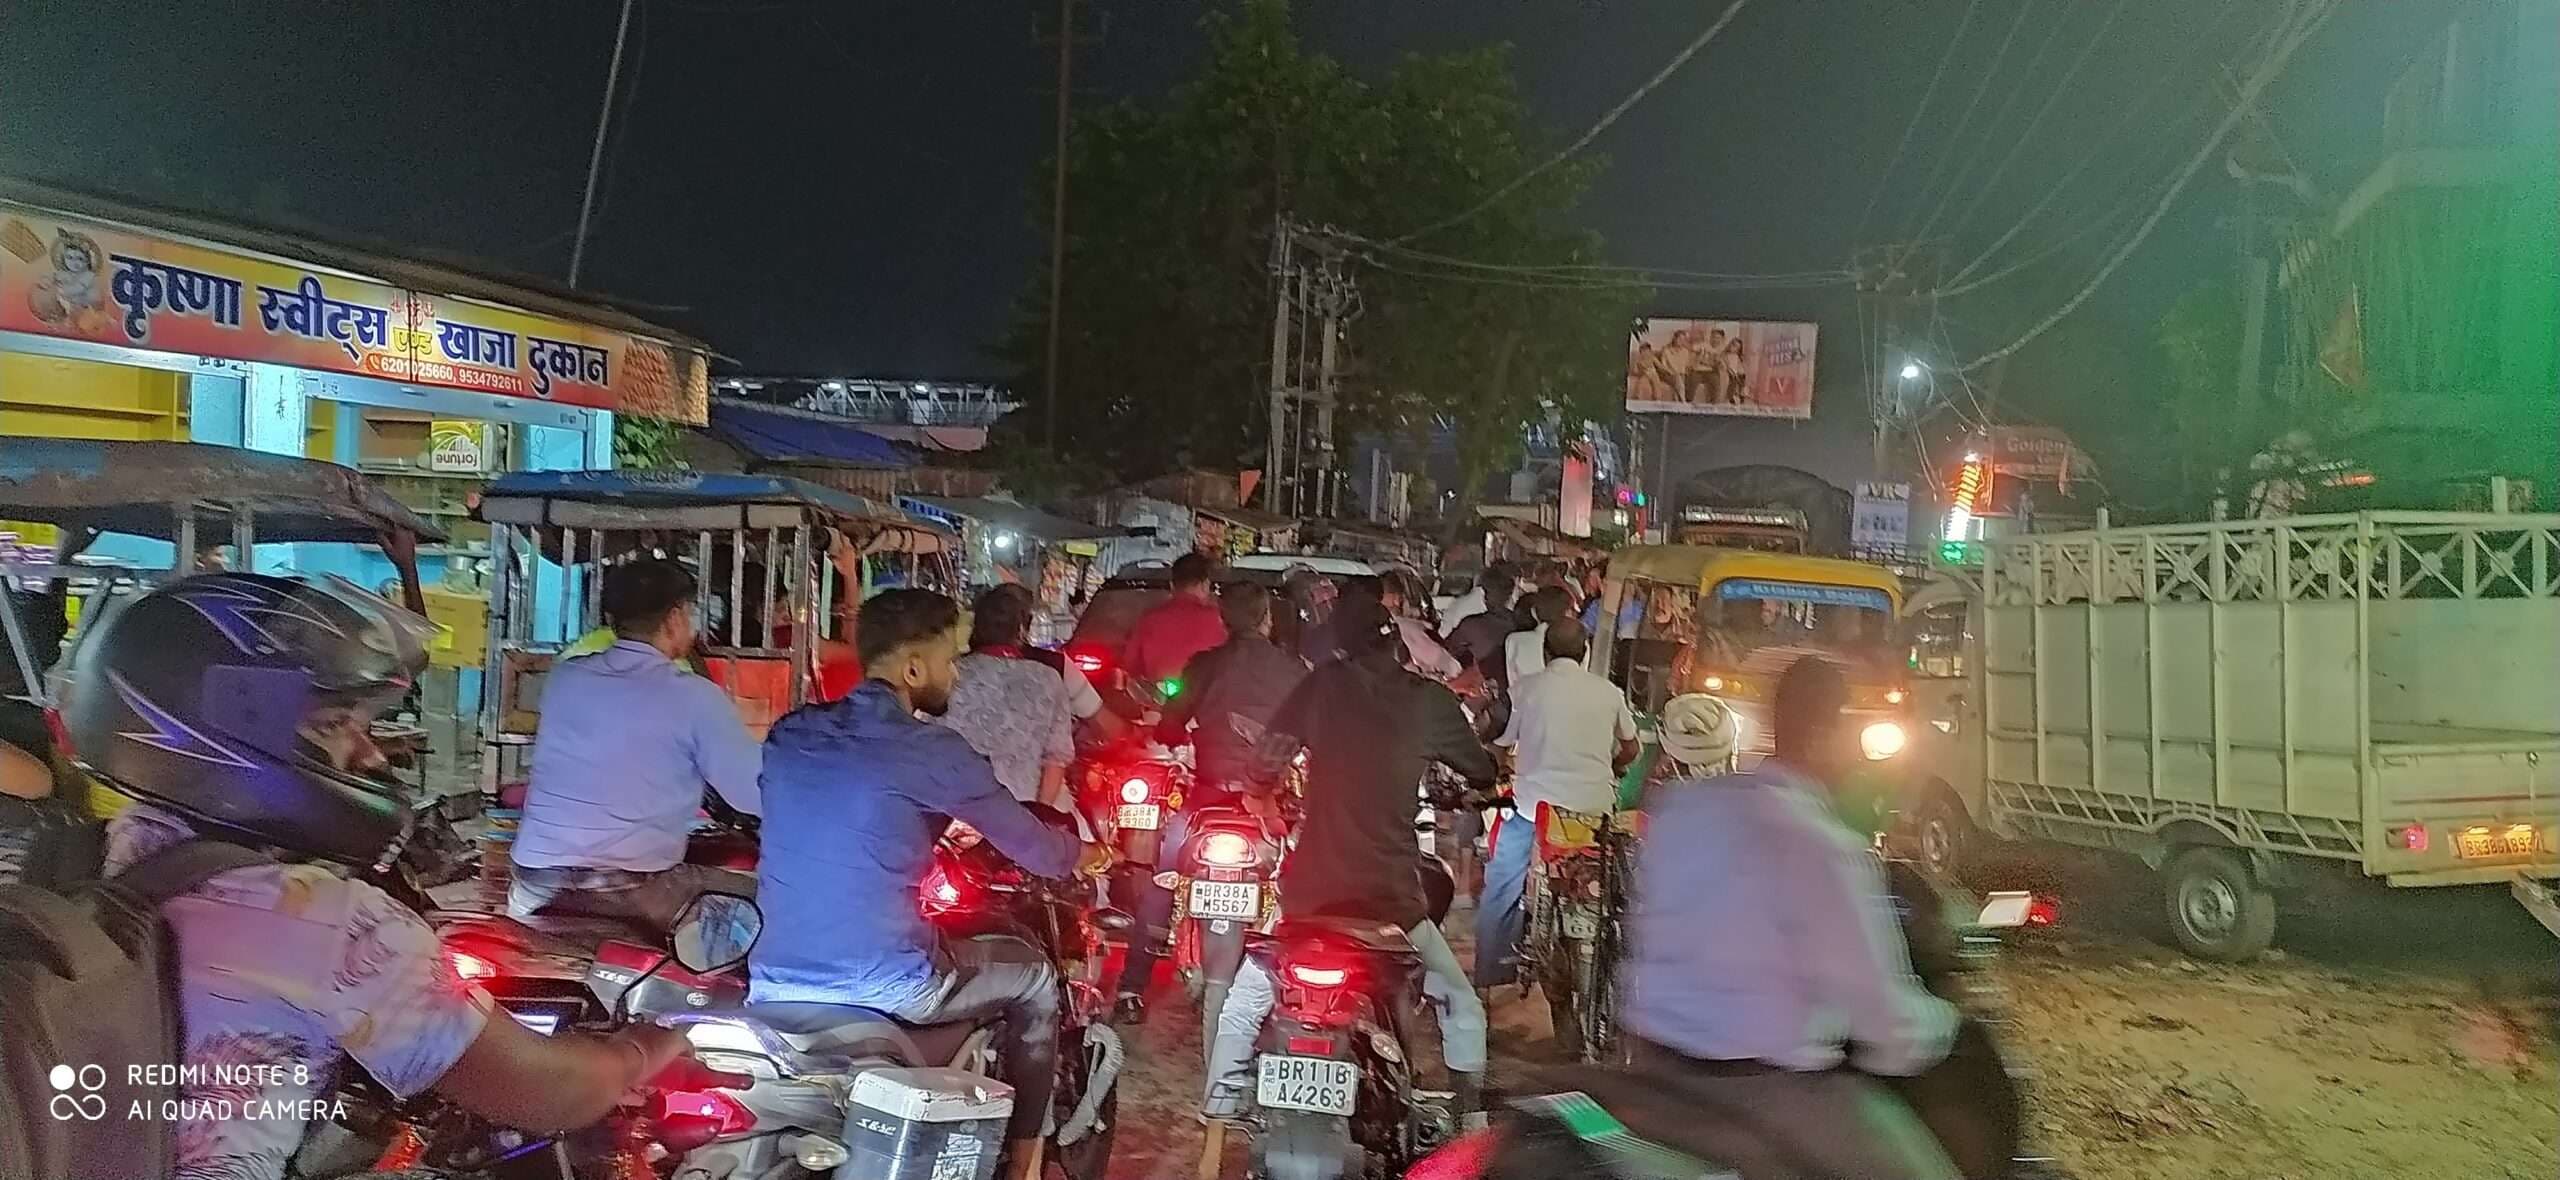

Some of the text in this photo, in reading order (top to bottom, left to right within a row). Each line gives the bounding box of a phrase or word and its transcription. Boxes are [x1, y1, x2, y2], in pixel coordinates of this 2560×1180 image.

[110, 254, 242, 339] कृष्णा
[256, 277, 388, 361] स्वीट्स
[437, 320, 516, 369] खाजा
[527, 336, 608, 395] दुकान
[459, 370, 523, 391] 9534792611
[436, 454, 478, 467] fortune
[1204, 884, 1249, 899] BR38A
[1203, 899, 1249, 913] M5567
[1278, 1060, 1347, 1085] BR11B
[1277, 1082, 1346, 1109] A4263
